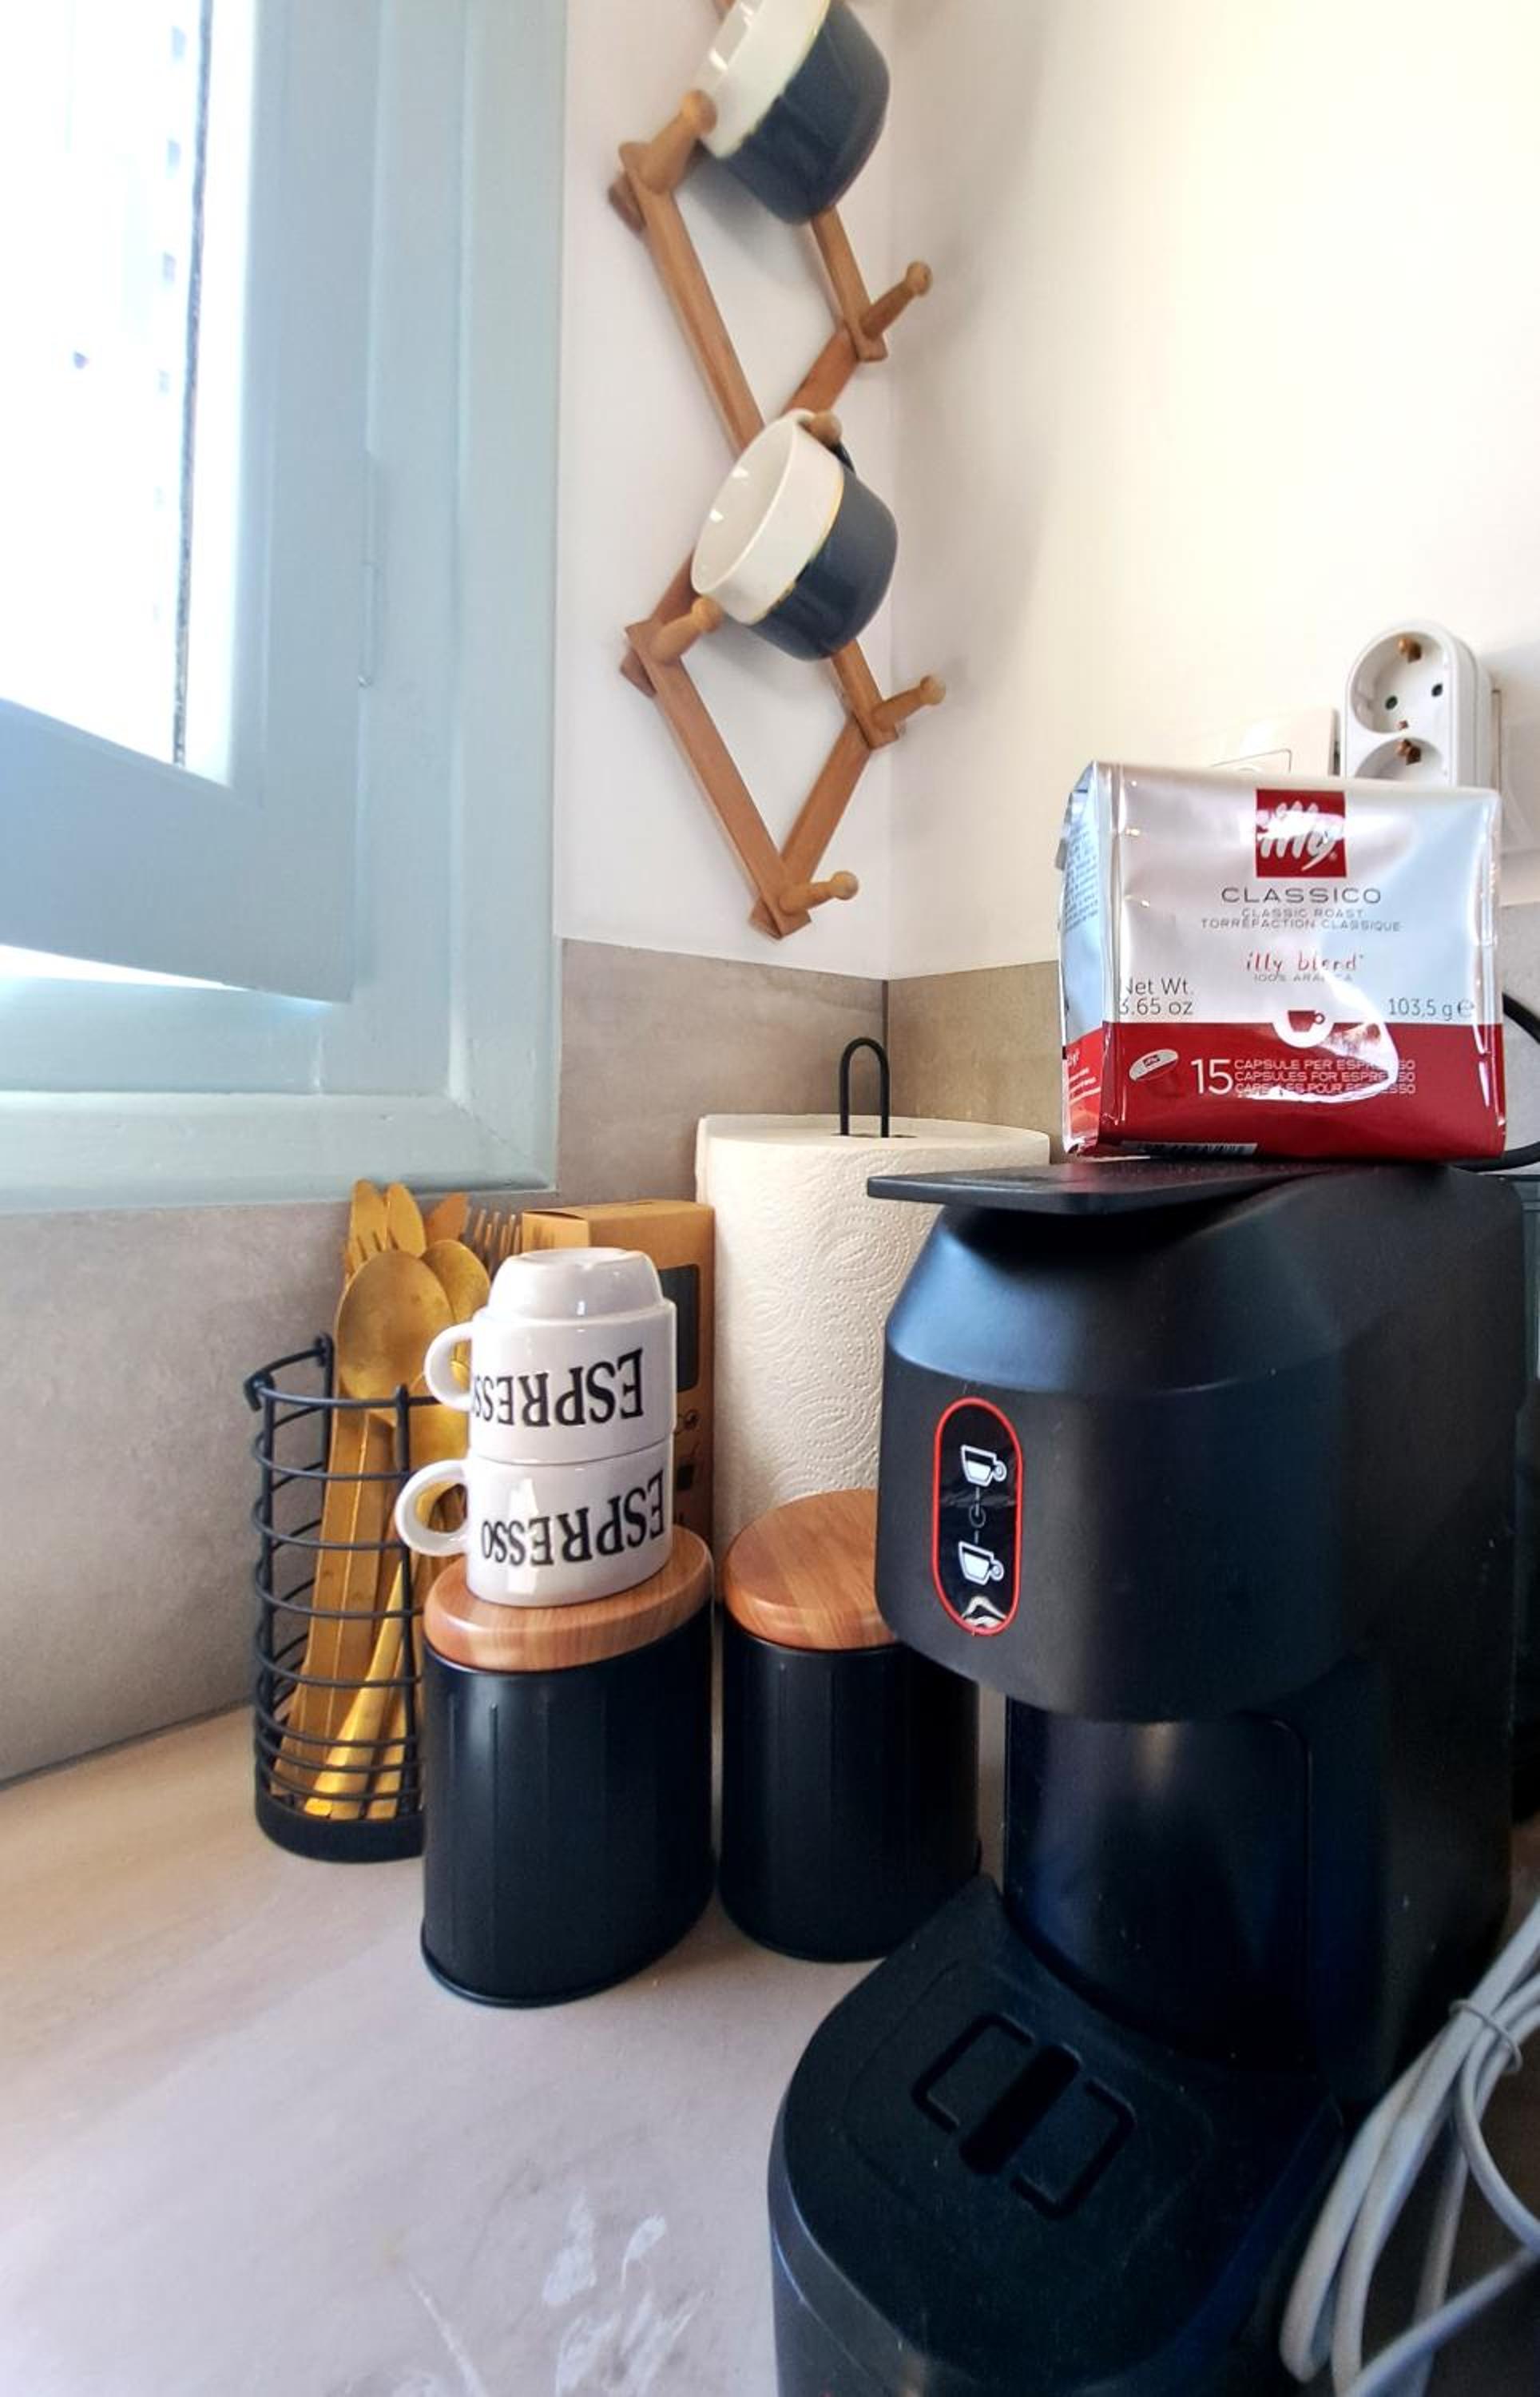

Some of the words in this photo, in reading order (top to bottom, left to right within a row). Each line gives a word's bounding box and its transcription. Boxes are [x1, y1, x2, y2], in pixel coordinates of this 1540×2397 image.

[1221, 887, 1381, 904] CLASSICO
[1241, 908, 1307, 918] CLASSIC
[1314, 908, 1364, 919] ROAST
[1320, 919, 1402, 932] CLASSIQUE
[1246, 952, 1283, 974] illy
[1169, 1000, 1193, 1015] oz
[1442, 1004, 1452, 1021] g
[1235, 1059, 1300, 1070] CAPSULE
[1304, 1059, 1332, 1070] PER
[1191, 1059, 1233, 1094] 15
[1235, 1071, 1308, 1082] CAPSULES
[1311, 1071, 1338, 1082] FOR
[1341, 1071, 1416, 1083] ESPRESO
[1308, 1083, 1343, 1094] POUR
[470, 1347, 644, 1428] ESPRESS
[481, 1469, 666, 1567] ESPRESSO
